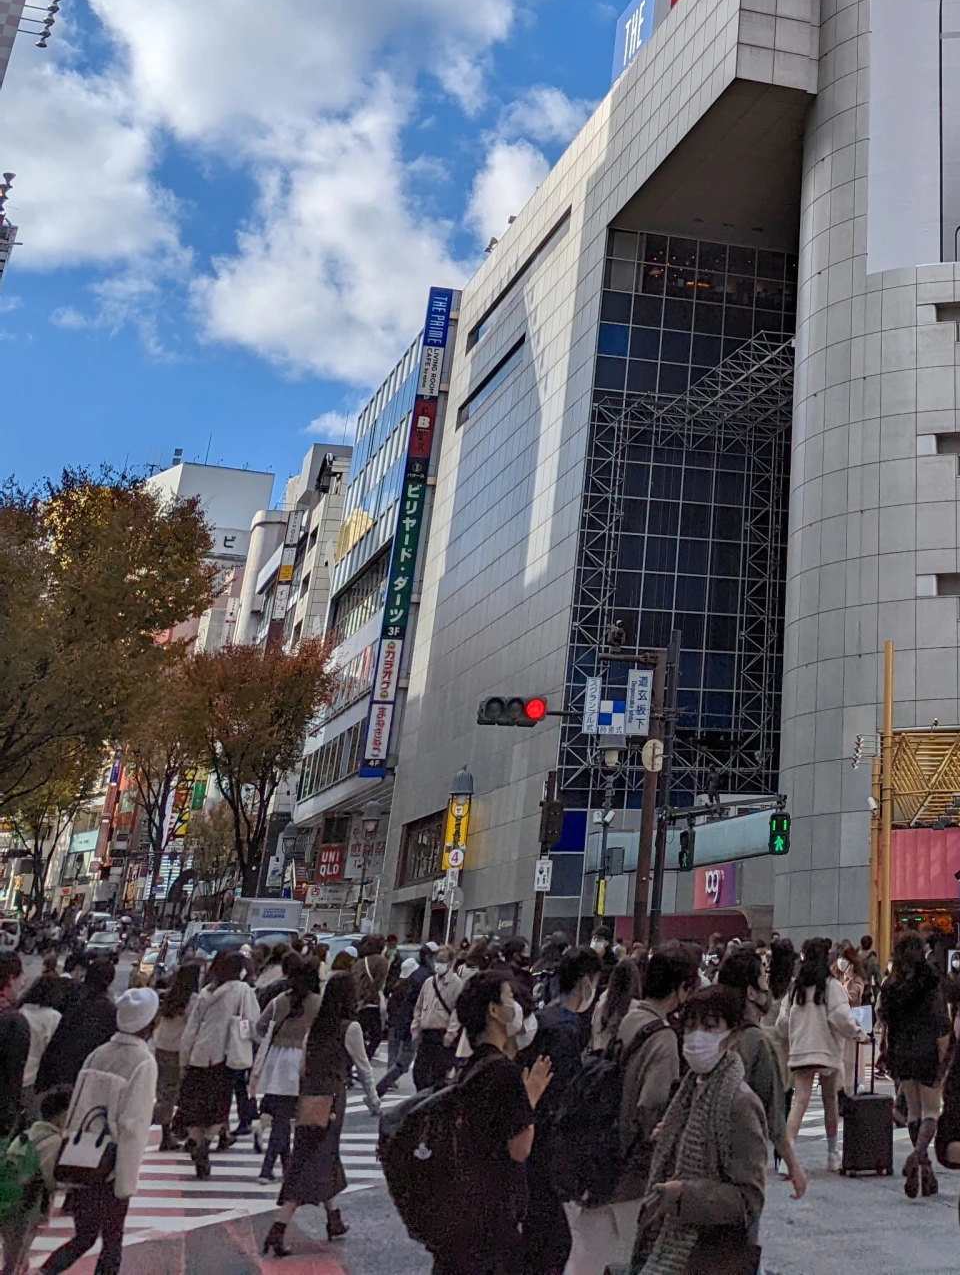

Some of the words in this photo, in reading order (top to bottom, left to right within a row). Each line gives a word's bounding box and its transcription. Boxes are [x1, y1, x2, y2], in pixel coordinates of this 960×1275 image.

[623, 0, 646, 66] THE
[431, 296, 448, 313] THE
[427, 314, 445, 344] PRIME
[424, 347, 433, 367] CAFE
[431, 348, 440, 372] LIVING
[428, 373, 437, 394] ROOM
[389, 483, 422, 623] ビリヤード・ダーツ
[387, 626, 401, 636] 3F
[381, 650, 395, 690] カラオケ
[586, 679, 598, 732] スクランブル式
[635, 676, 649, 730] 道玄坂下
[368, 759, 380, 767] 4F
[321, 851, 340, 863] UNI
[451, 851, 459, 864] 4
[319, 864, 340, 877] QLO
[705, 869, 720, 903] 109
